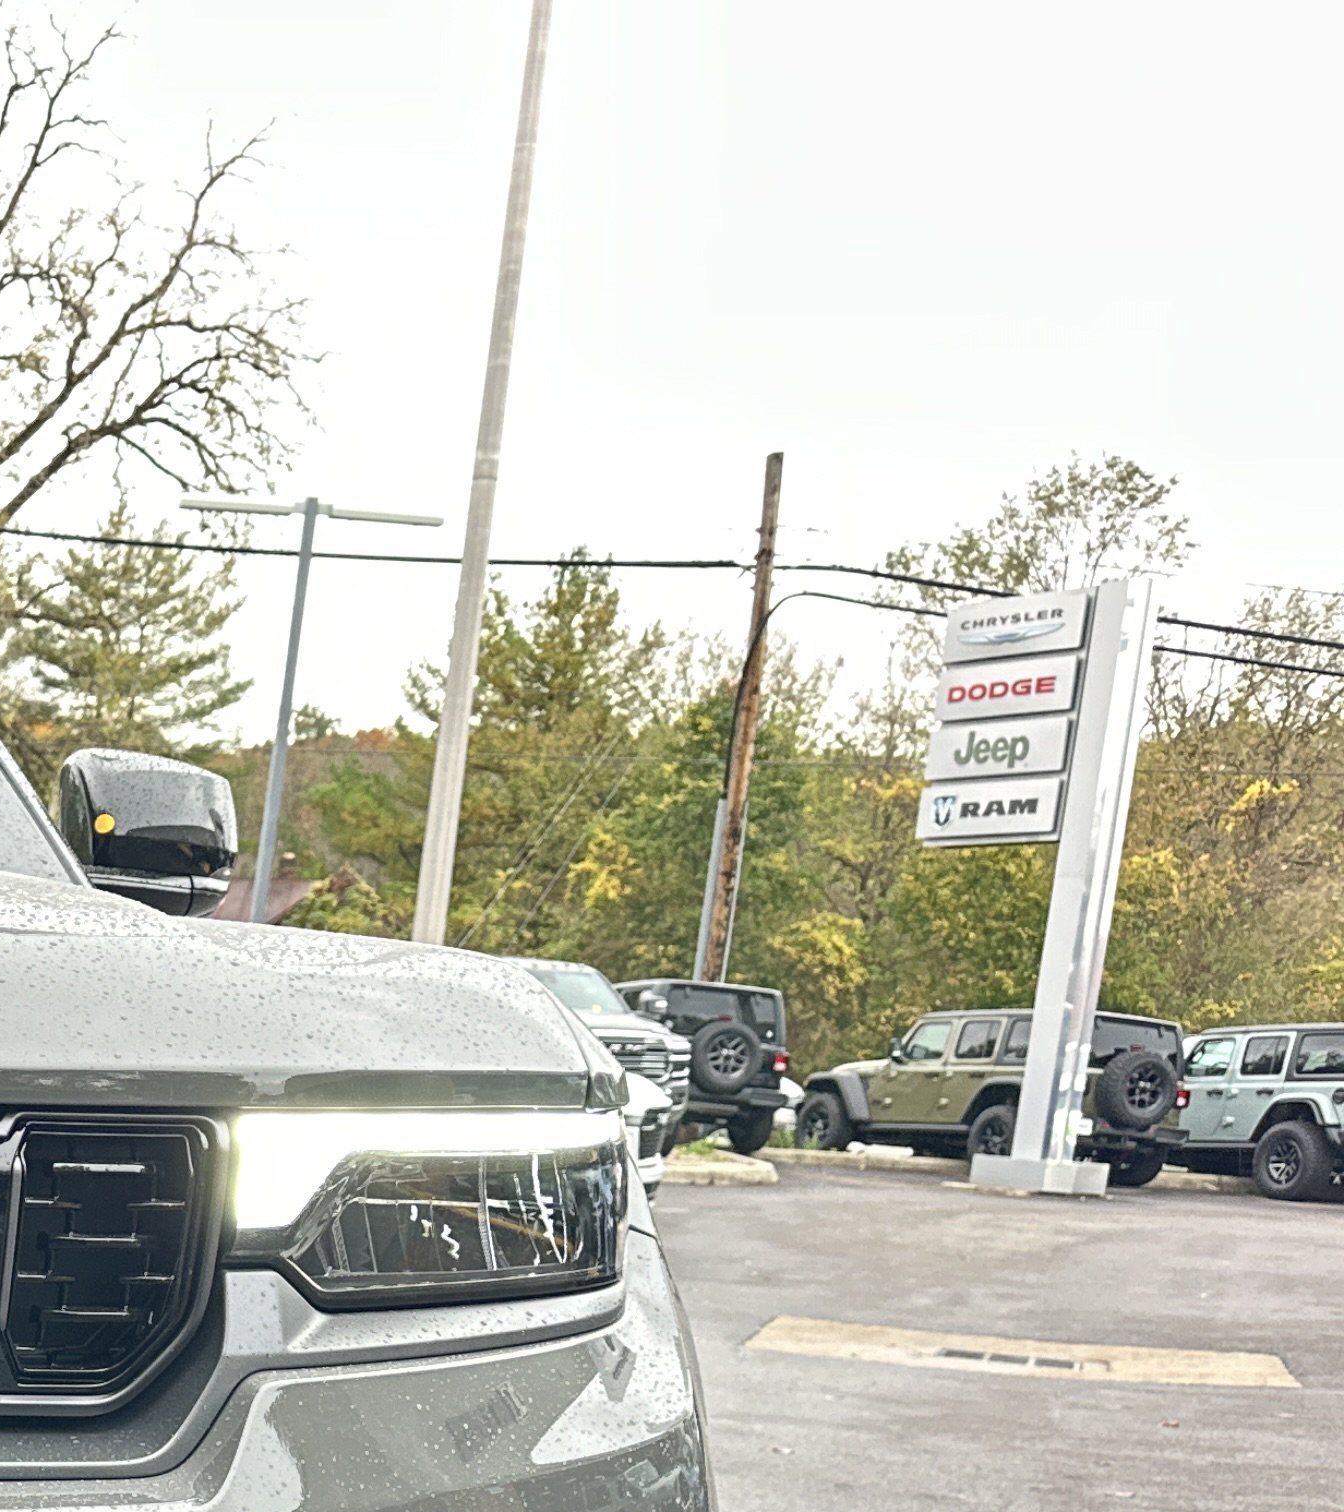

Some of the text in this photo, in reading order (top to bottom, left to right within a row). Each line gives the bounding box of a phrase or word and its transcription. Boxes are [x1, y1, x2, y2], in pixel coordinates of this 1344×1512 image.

[960, 608, 1064, 631] CHRYSLER
[947, 676, 1057, 704] DODGE
[953, 731, 1030, 768] Jeep
[959, 798, 1039, 818] RAM
